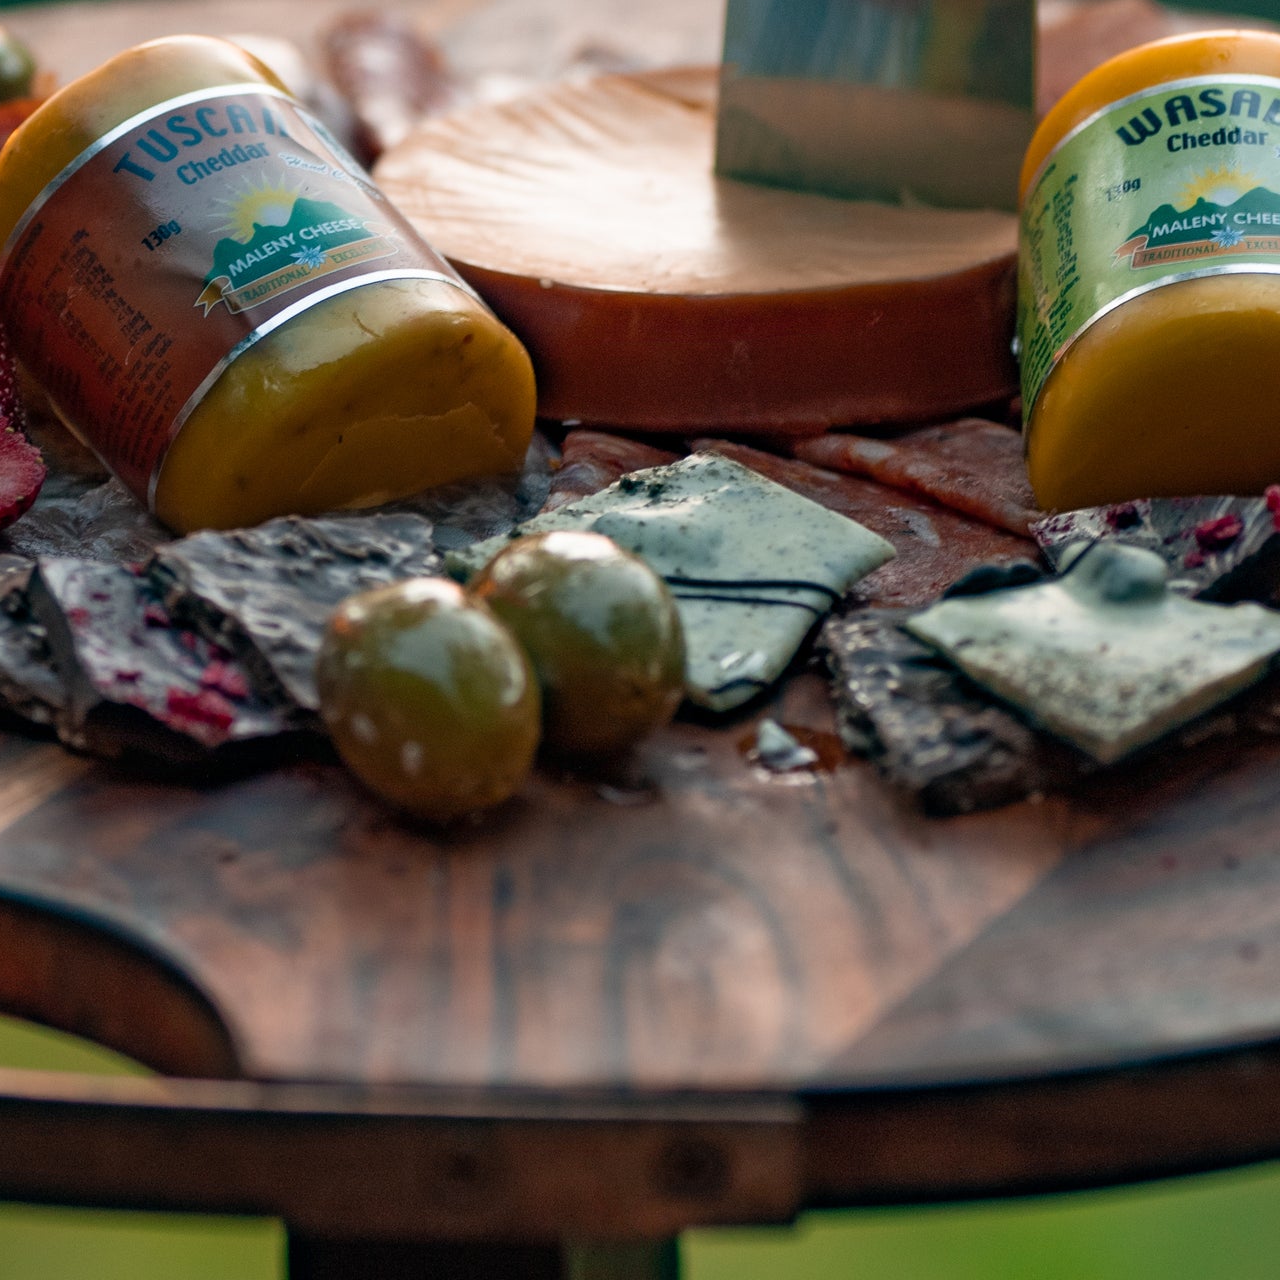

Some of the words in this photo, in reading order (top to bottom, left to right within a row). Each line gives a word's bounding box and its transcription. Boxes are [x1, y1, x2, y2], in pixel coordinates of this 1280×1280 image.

[1167, 126, 1269, 153] Cheddar
[176, 141, 270, 186] Cheddar
[141, 219, 183, 252] 130g
[1152, 212, 1228, 239] MALENY
[228, 232, 296, 277] MALENY
[299, 218, 362, 241] CHEESE
[1142, 243, 1218, 263] TRADITIONAL
[236, 266, 311, 304] TRADITIONAL
